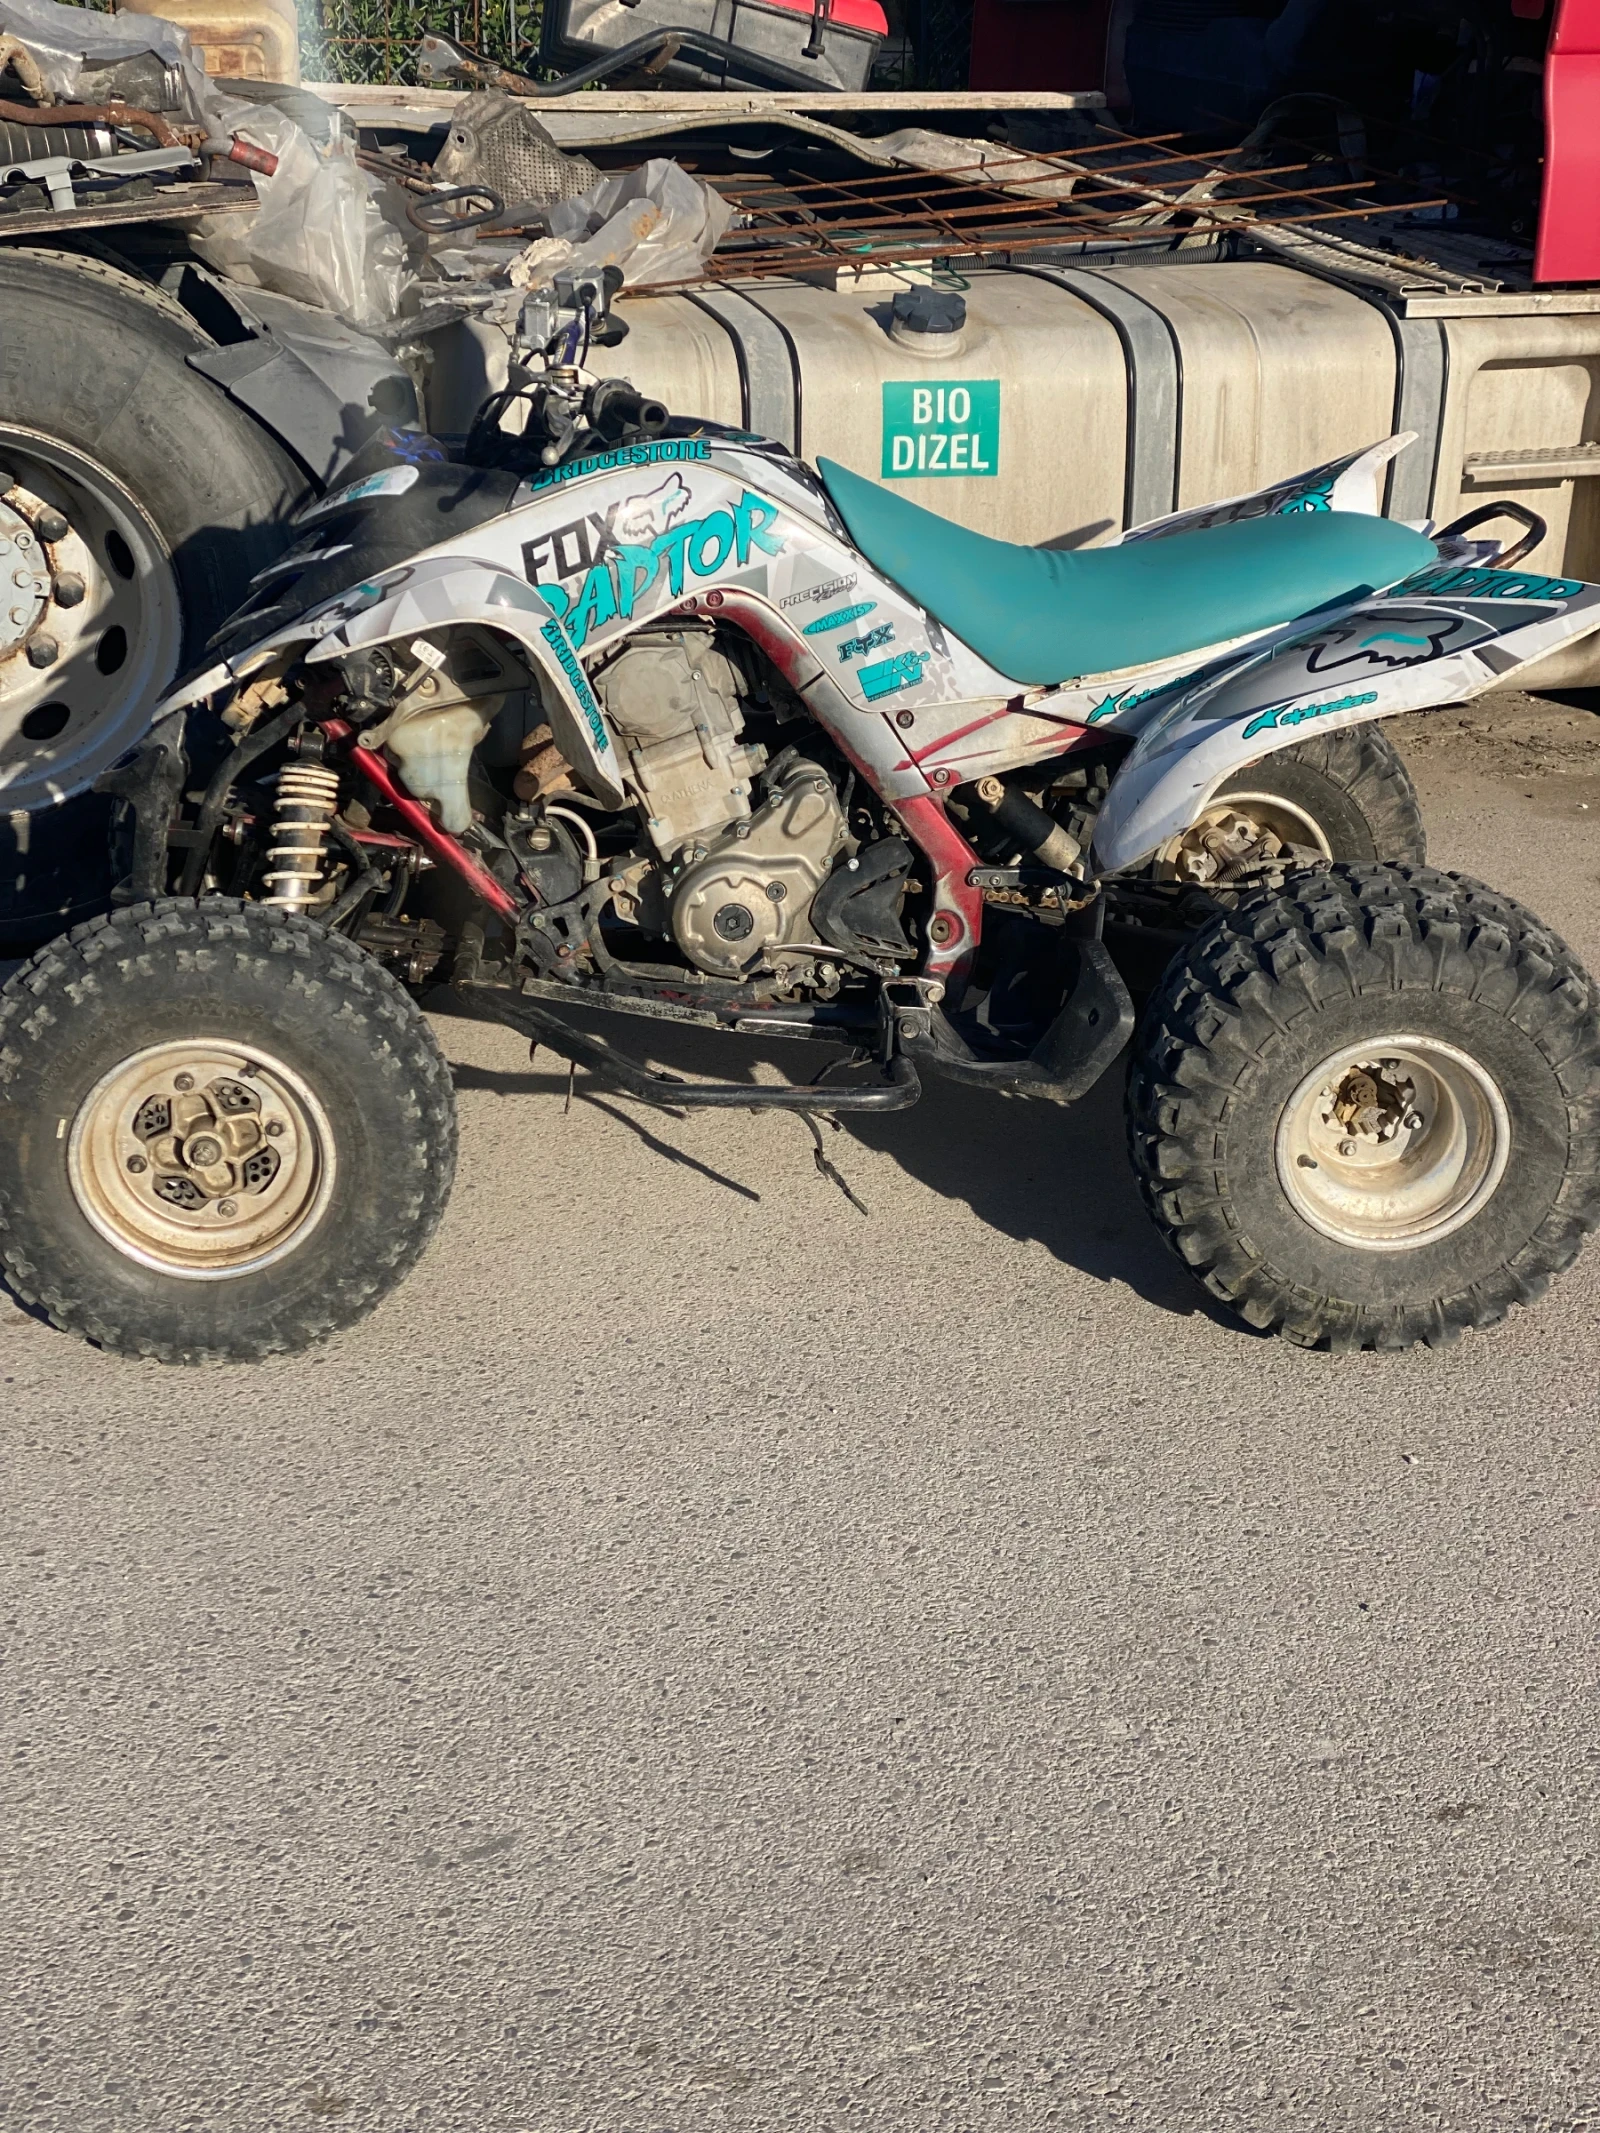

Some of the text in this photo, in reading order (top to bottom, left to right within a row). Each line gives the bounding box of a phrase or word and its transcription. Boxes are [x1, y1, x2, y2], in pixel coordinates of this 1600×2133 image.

[912, 387, 971, 424] BIO
[531, 440, 711, 491] BRIDGESTONE
[892, 433, 989, 471] DIZEL
[520, 501, 622, 586] FOX
[780, 572, 857, 609] PRECISION
[815, 606, 865, 633] MAXXIS
[540, 618, 610, 754] BRIDGESTONE
[1118, 669, 1204, 711] alpinestars
[1280, 691, 1378, 726] alpinestars
